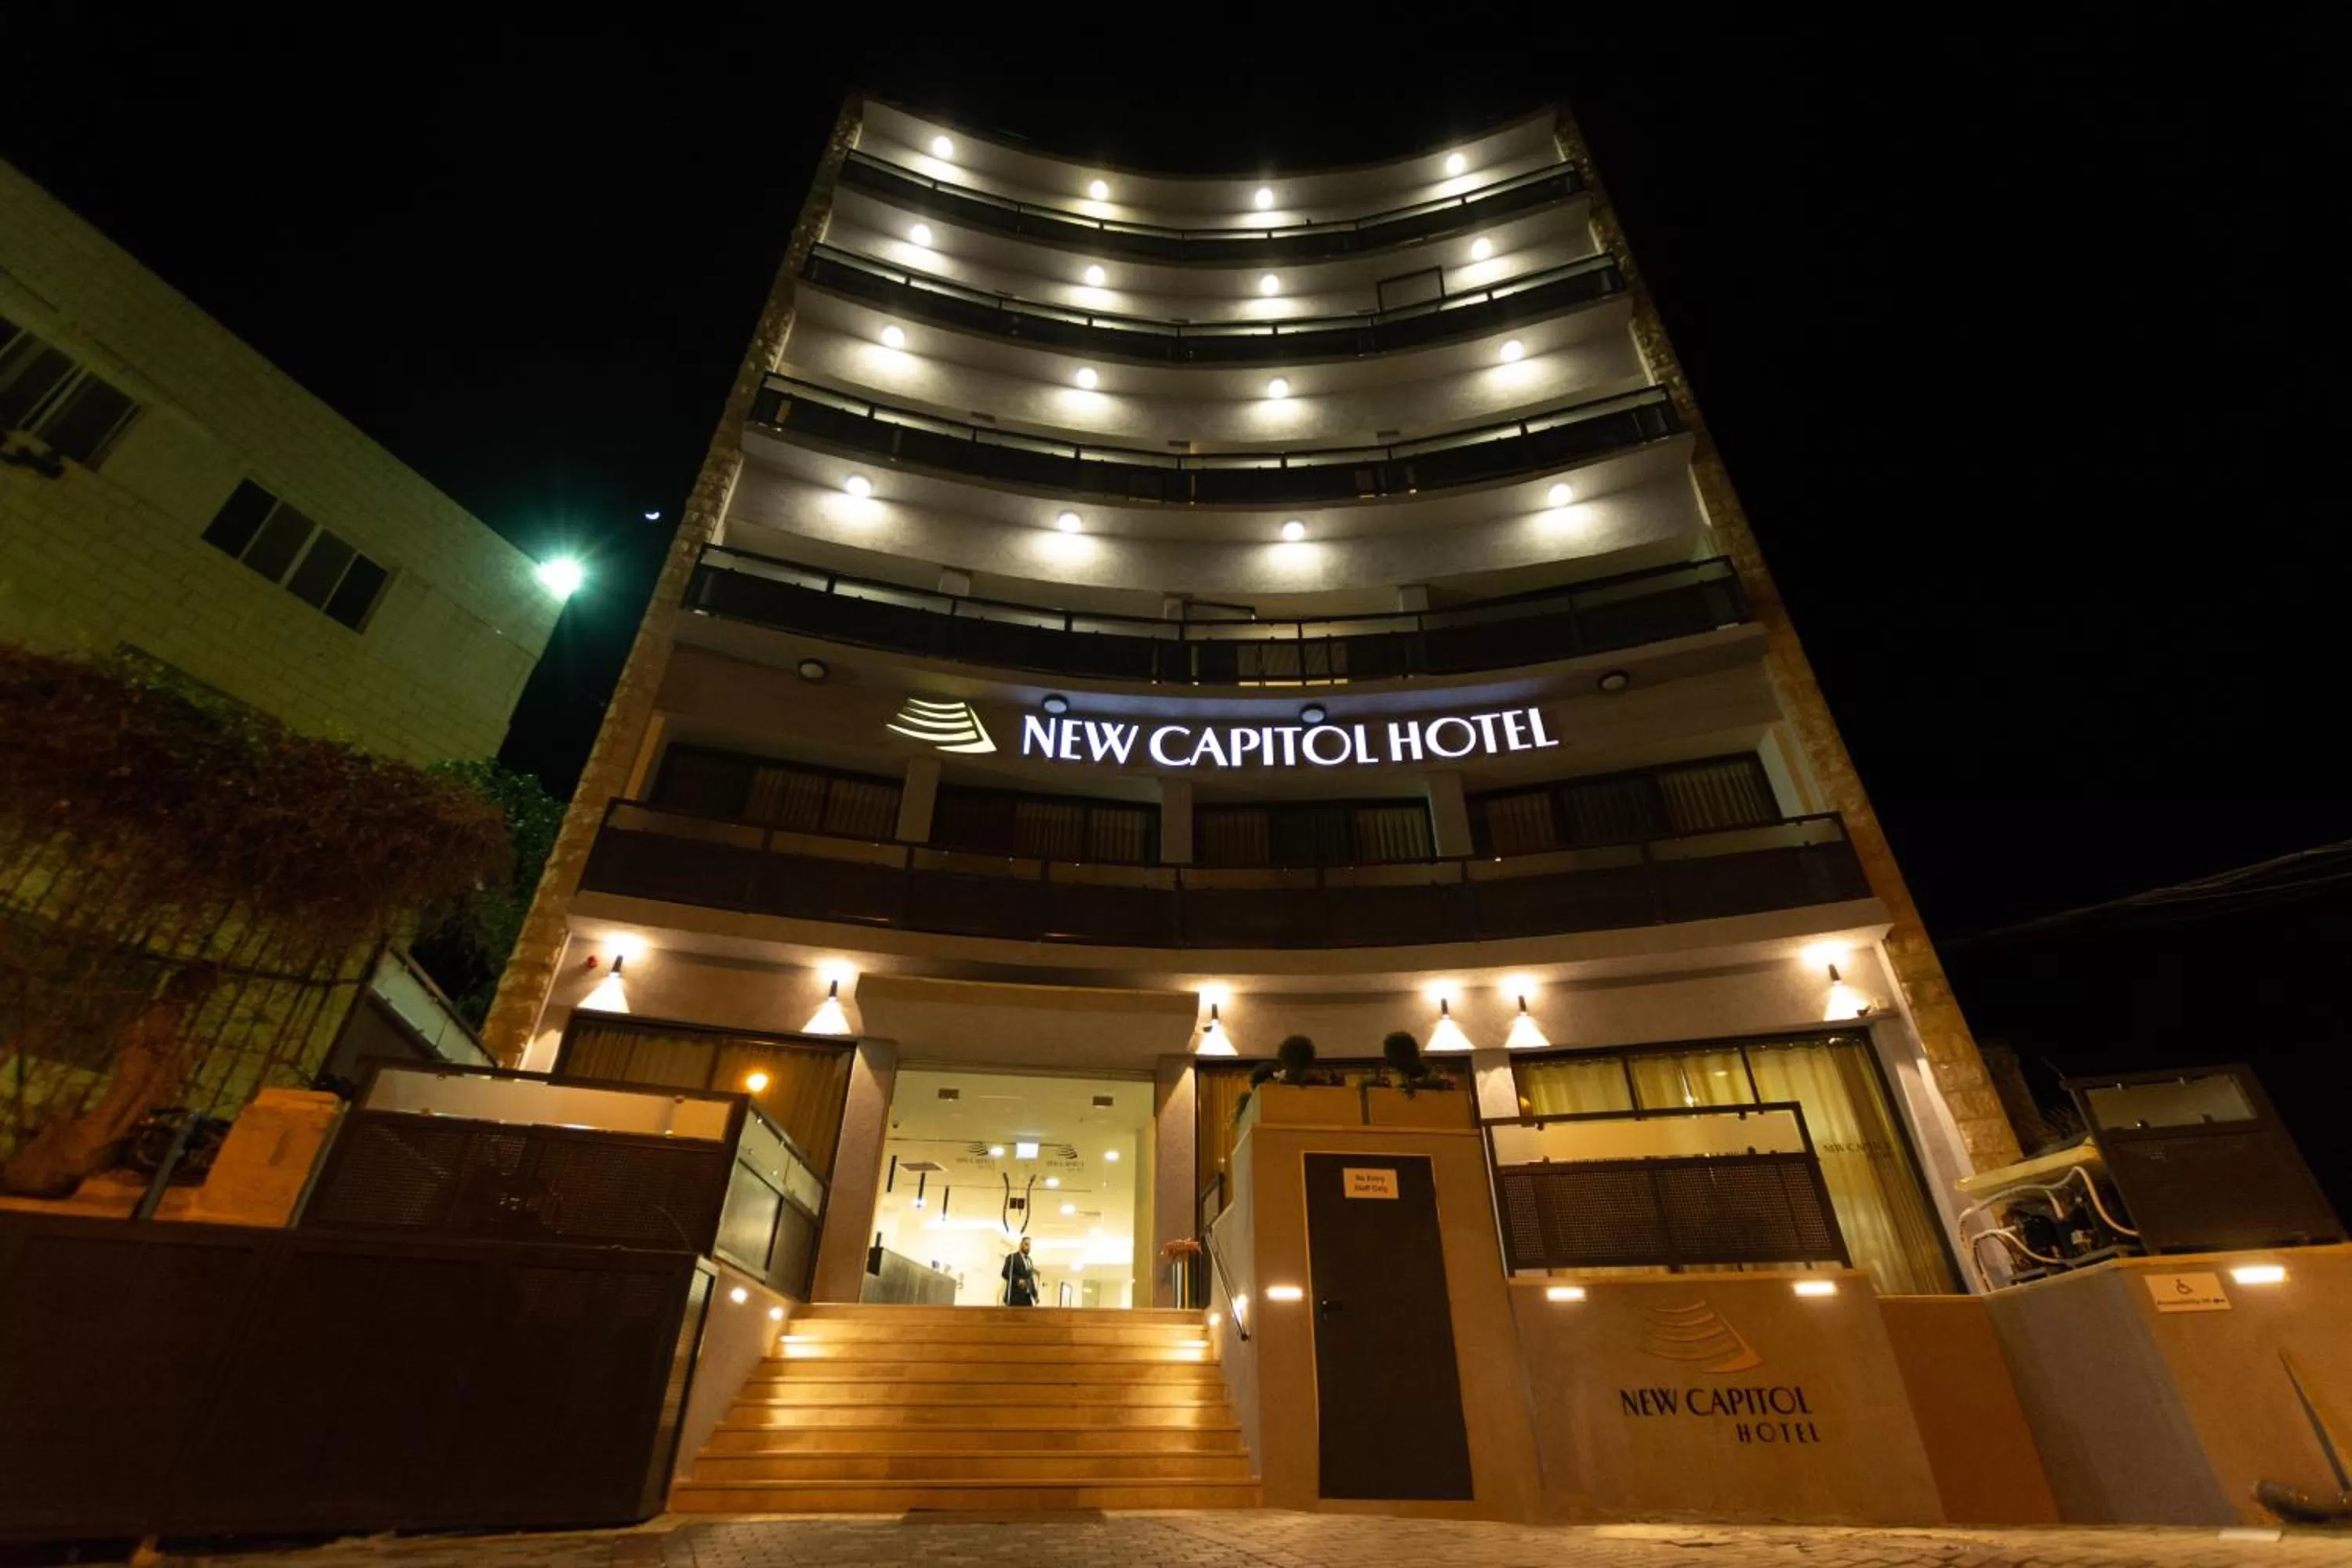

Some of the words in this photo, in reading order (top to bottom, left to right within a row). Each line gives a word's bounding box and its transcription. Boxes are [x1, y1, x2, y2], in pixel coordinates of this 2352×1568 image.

[1023, 714, 1139, 764] NEW
[1149, 724, 1380, 767] CAPITOL
[1388, 708, 1559, 761] HOTEL
[1620, 1388, 1678, 1417] NEW
[1686, 1385, 1813, 1417] CAPITOL
[1736, 1421, 1820, 1443] HOTEL
